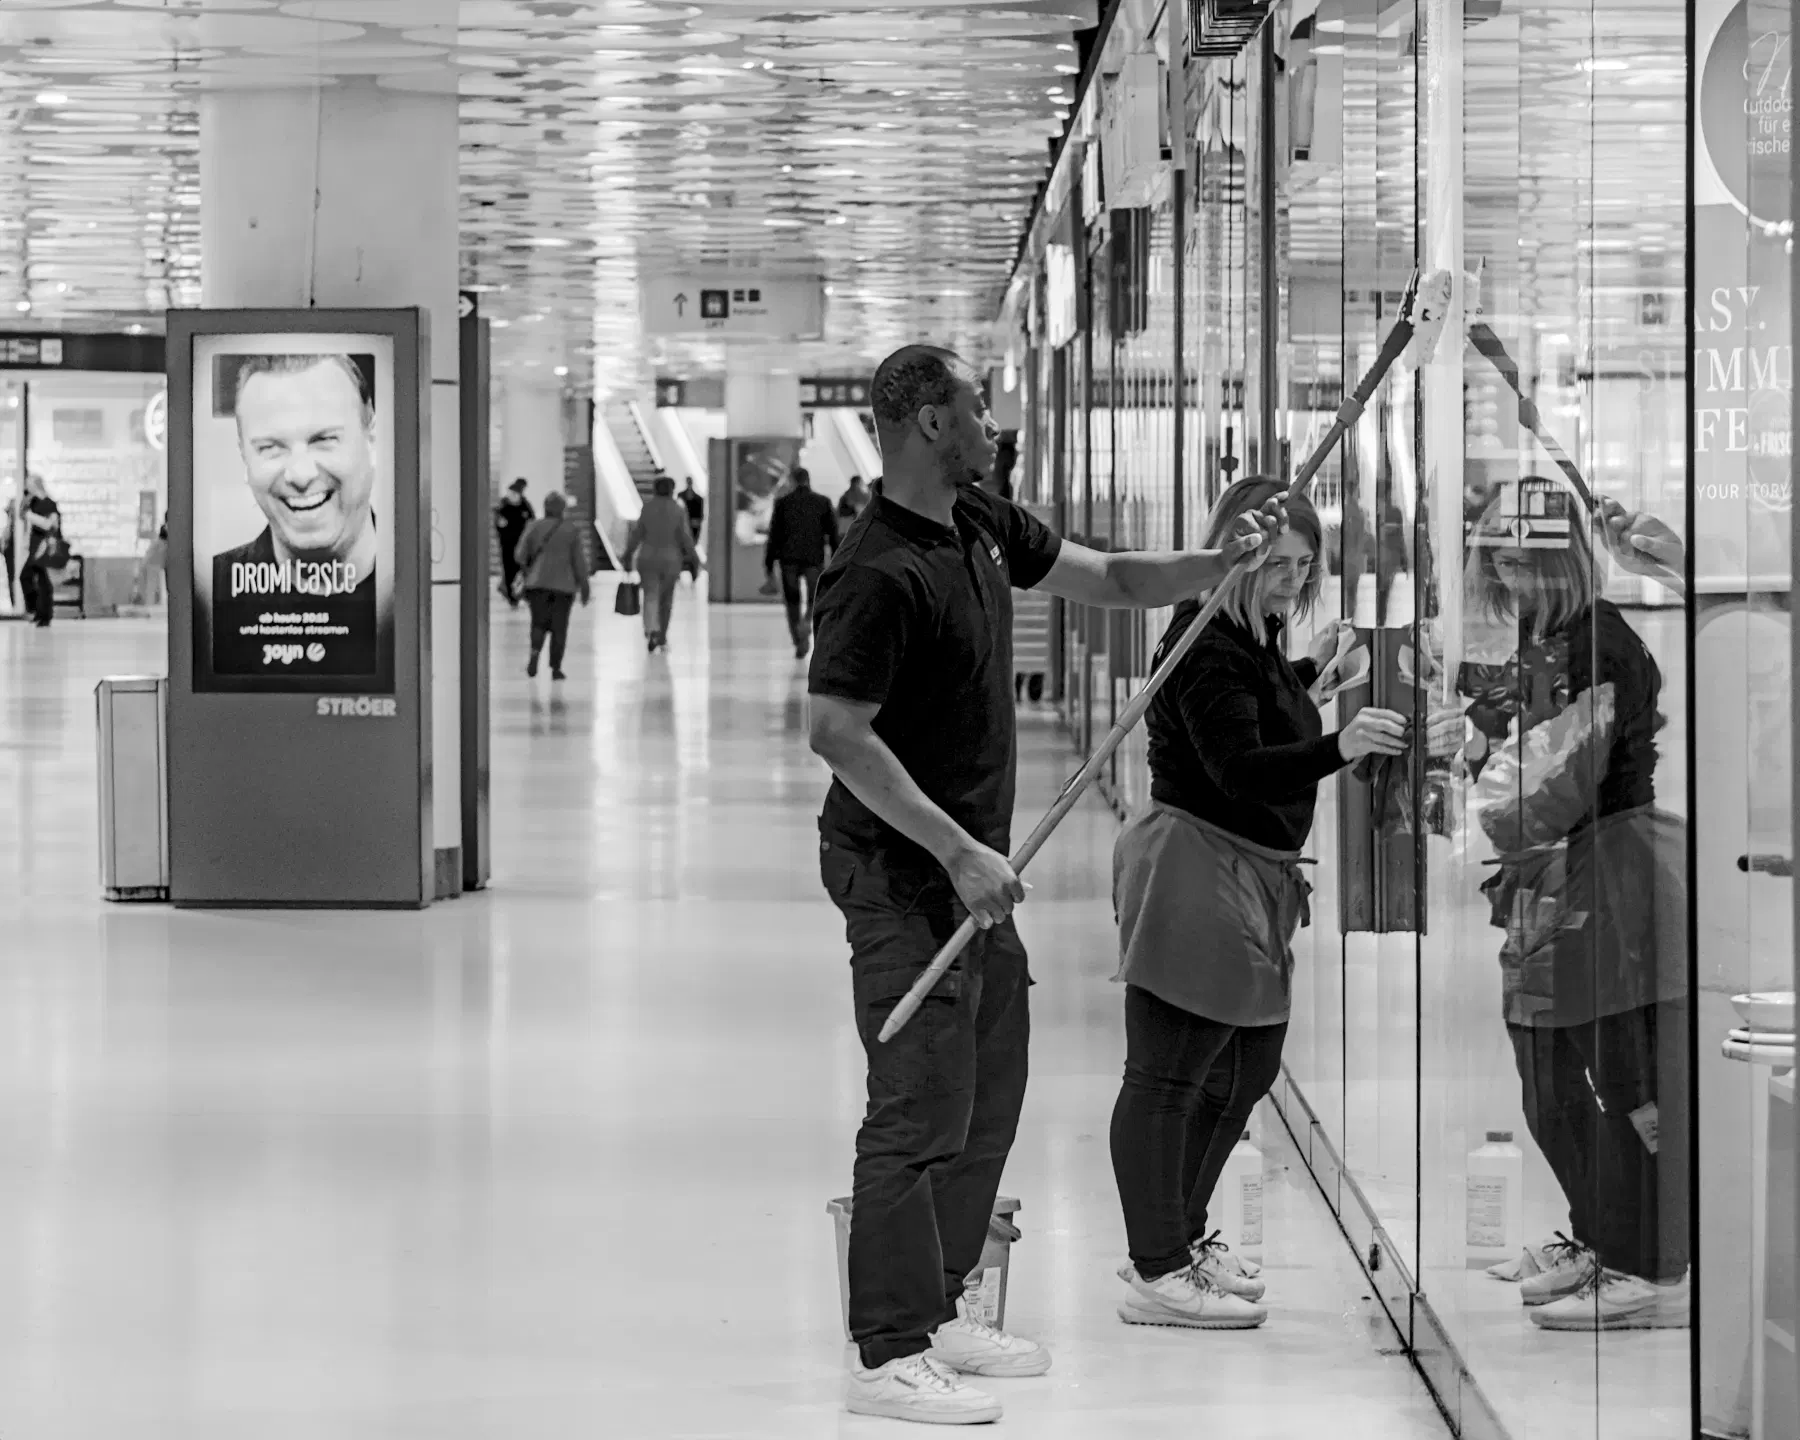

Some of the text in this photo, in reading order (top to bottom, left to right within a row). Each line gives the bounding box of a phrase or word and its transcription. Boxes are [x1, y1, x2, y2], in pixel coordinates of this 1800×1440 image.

[1759, 115, 1778, 133] für
[1696, 484, 1739, 499] YOUR
[296, 559, 356, 597] taste
[273, 612, 302, 623] heute
[239, 624, 349, 635] und kostenlos streamen
[263, 644, 304, 665] joyn
[317, 697, 397, 716] STRÖER
